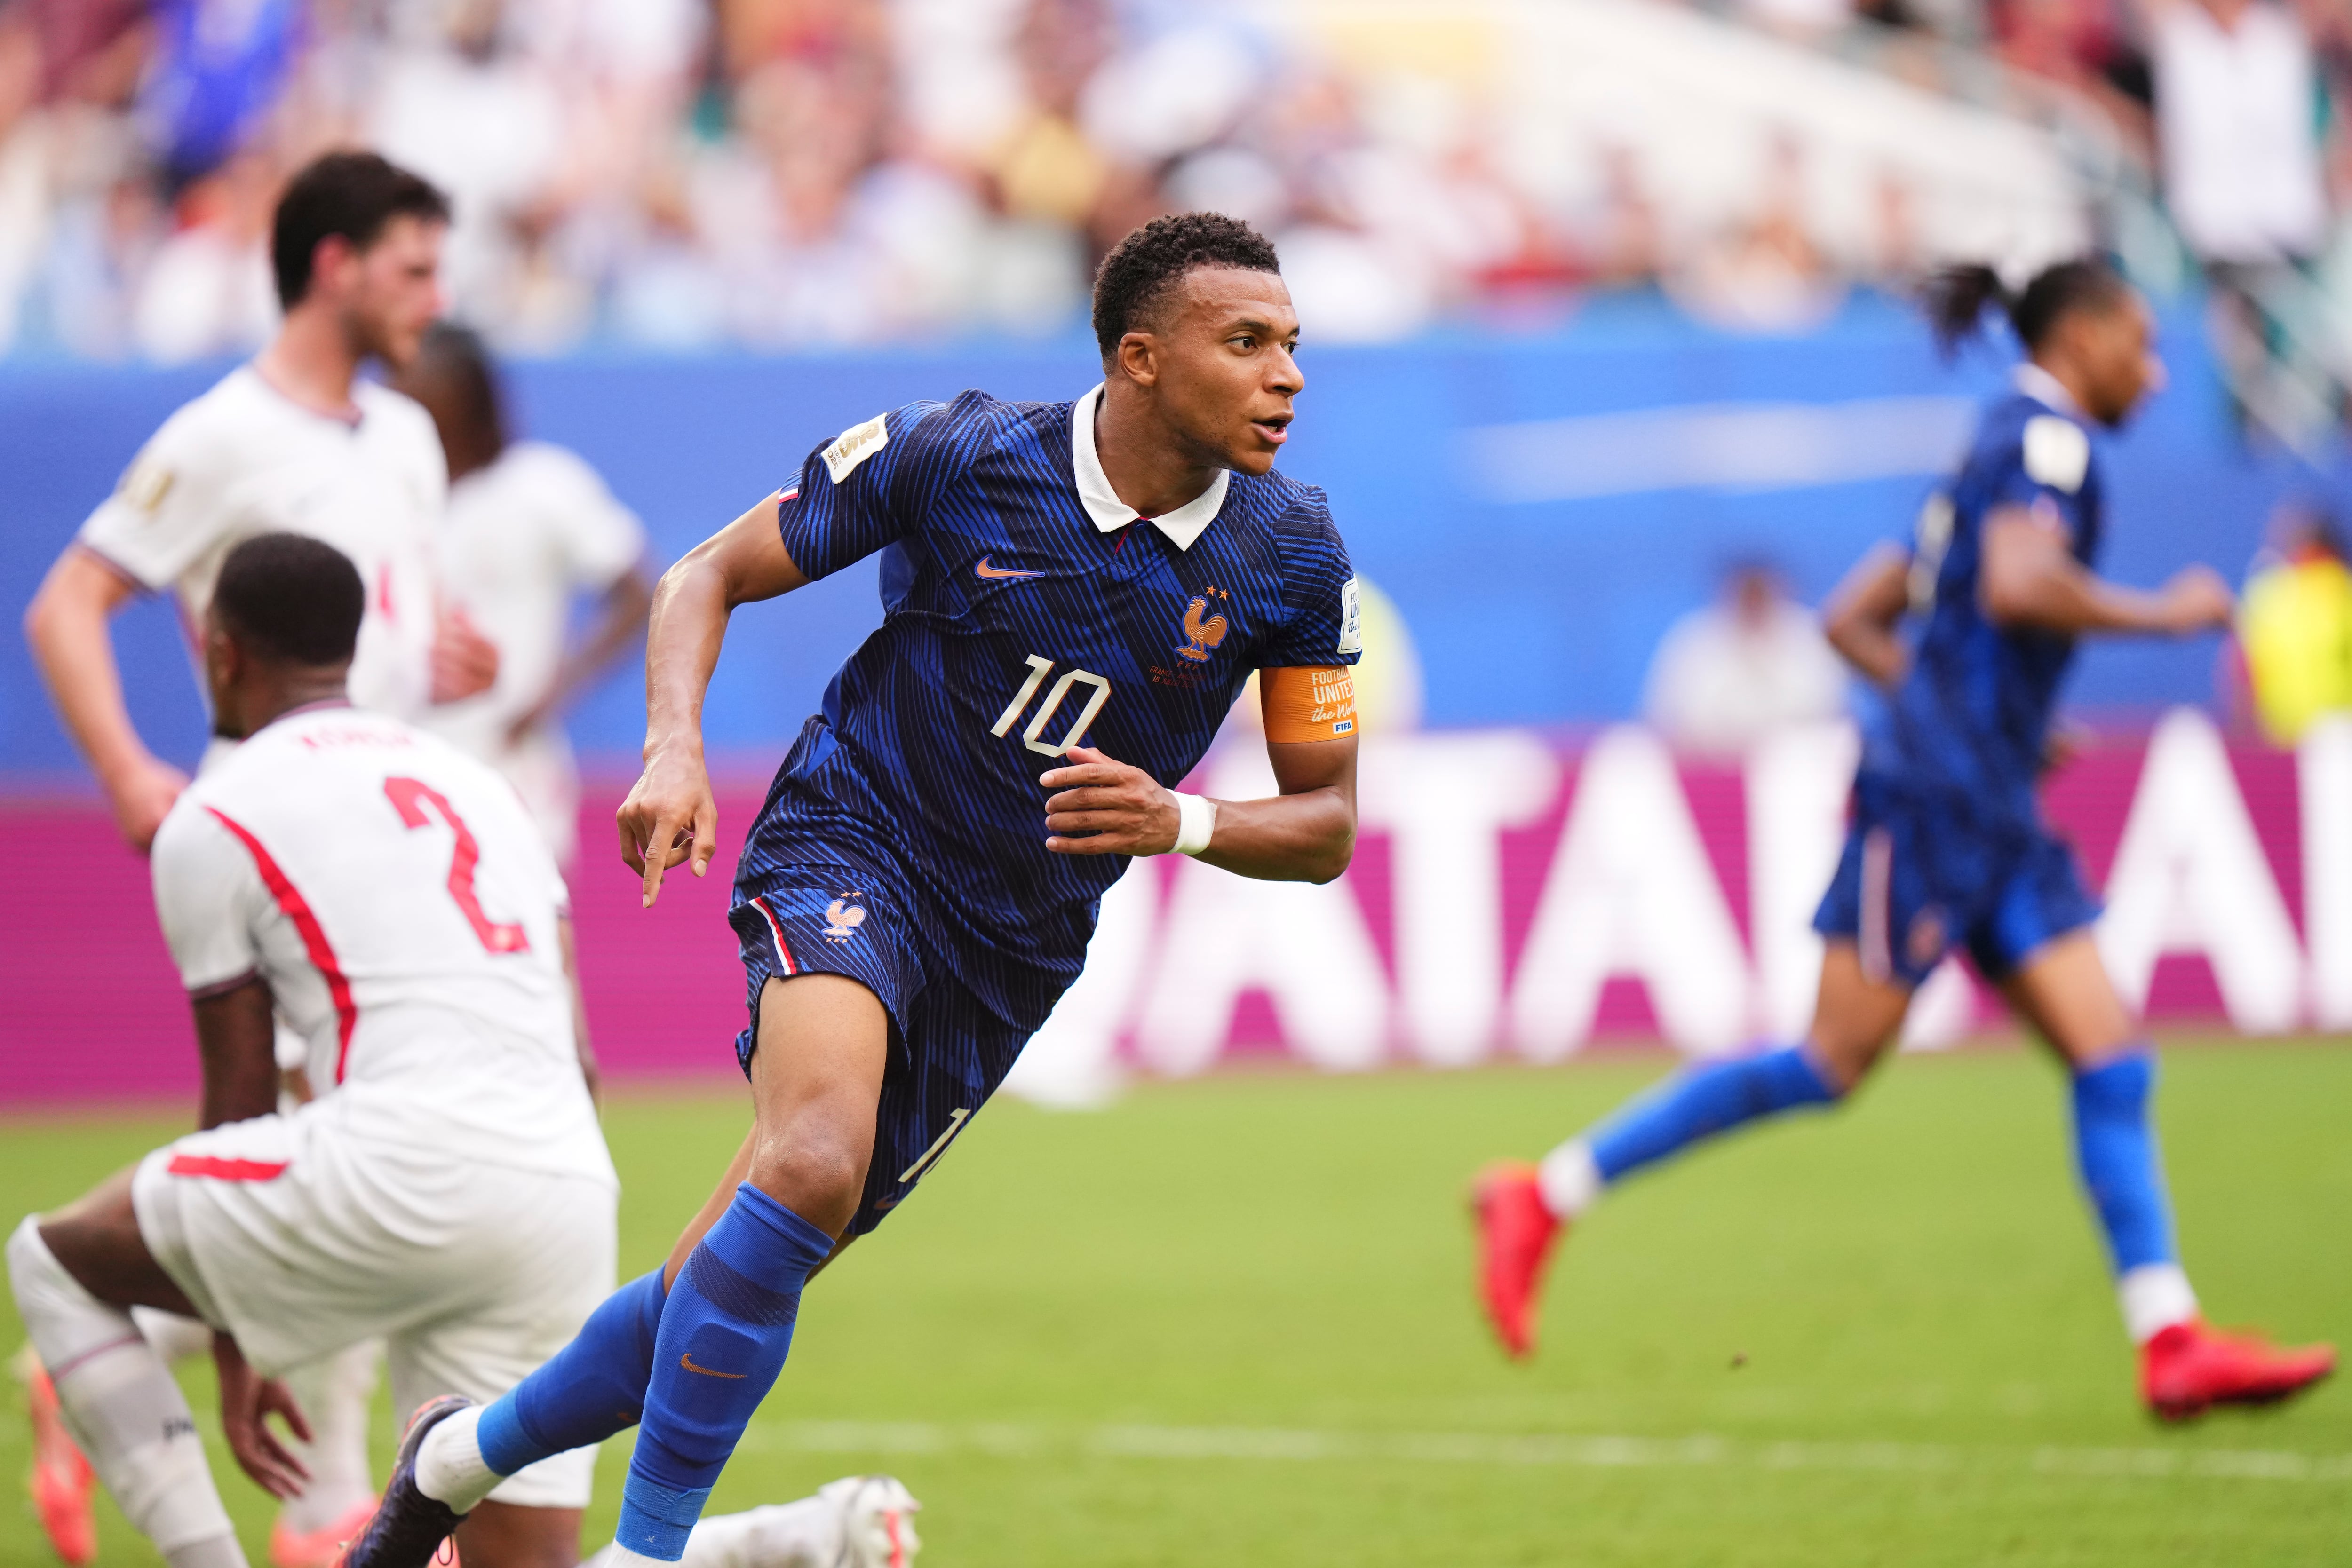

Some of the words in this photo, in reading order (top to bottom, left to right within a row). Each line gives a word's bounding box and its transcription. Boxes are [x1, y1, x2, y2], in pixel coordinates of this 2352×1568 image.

[826, 448, 838, 470] 026
[1150, 666, 1172, 677] FRANCE
[1312, 666, 1349, 685] FOOTBALL
[1313, 678, 1354, 705] UNITES
[990, 654, 1112, 758] 10
[1311, 705, 1335, 722] the
[1335, 722, 1351, 732] FIFA
[383, 776, 530, 955] 2
